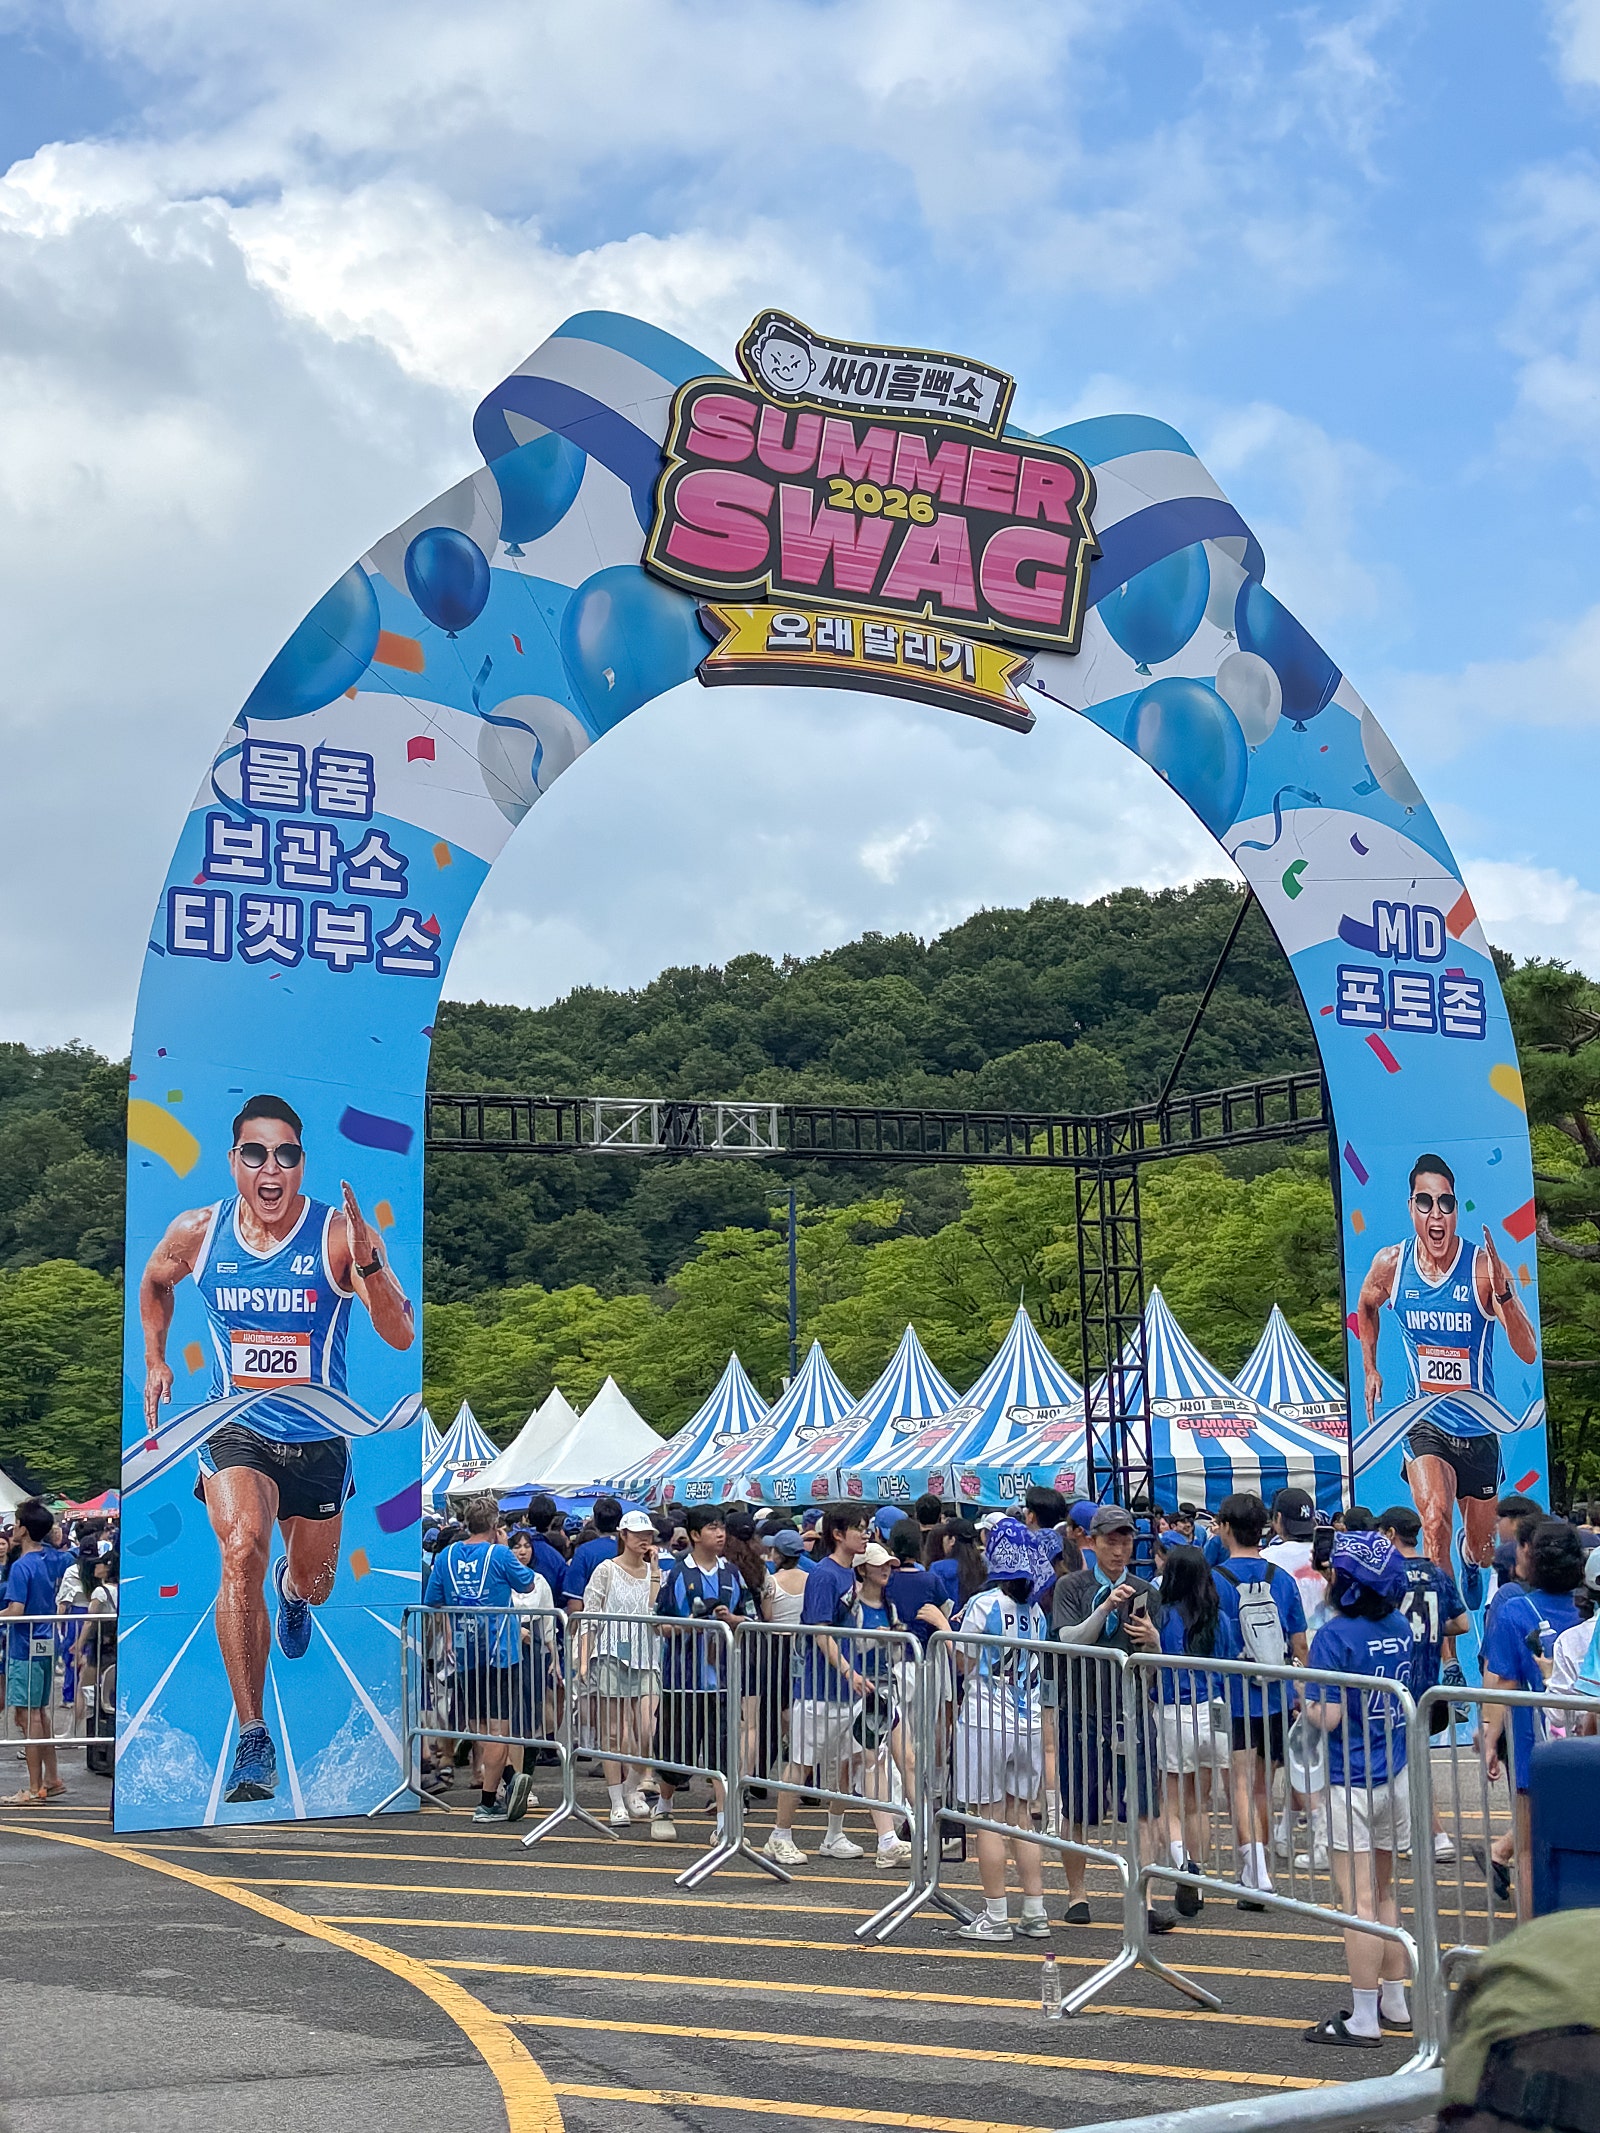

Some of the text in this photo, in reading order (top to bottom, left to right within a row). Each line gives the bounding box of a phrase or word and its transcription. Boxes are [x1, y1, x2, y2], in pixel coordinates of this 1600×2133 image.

[819, 355, 983, 413] 싸이흠뻑쇼
[685, 392, 1077, 526] SUMMER
[827, 478, 935, 523] 2026
[665, 468, 1072, 626] SWAG
[767, 614, 977, 682] 오래 달리기
[244, 742, 372, 817] 물품
[207, 817, 405, 894] 보관소
[171, 891, 437, 974] 티켓부스
[1375, 903, 1444, 959] MD
[1339, 968, 1484, 1036] 포토존
[290, 1255, 315, 1275] 42
[1453, 1285, 1469, 1301] 42
[1406, 1310, 1472, 1332] INPSYDER
[244, 1349, 297, 1374] 2026
[1428, 1360, 1462, 1380] 2026
[1177, 1419, 1257, 1430] SUMMER
[1200, 1428, 1250, 1438] SWAG
[458, 1560, 478, 1574] PSY
[1004, 1613, 1040, 1633] PSY
[1367, 1636, 1411, 1657] PSY
